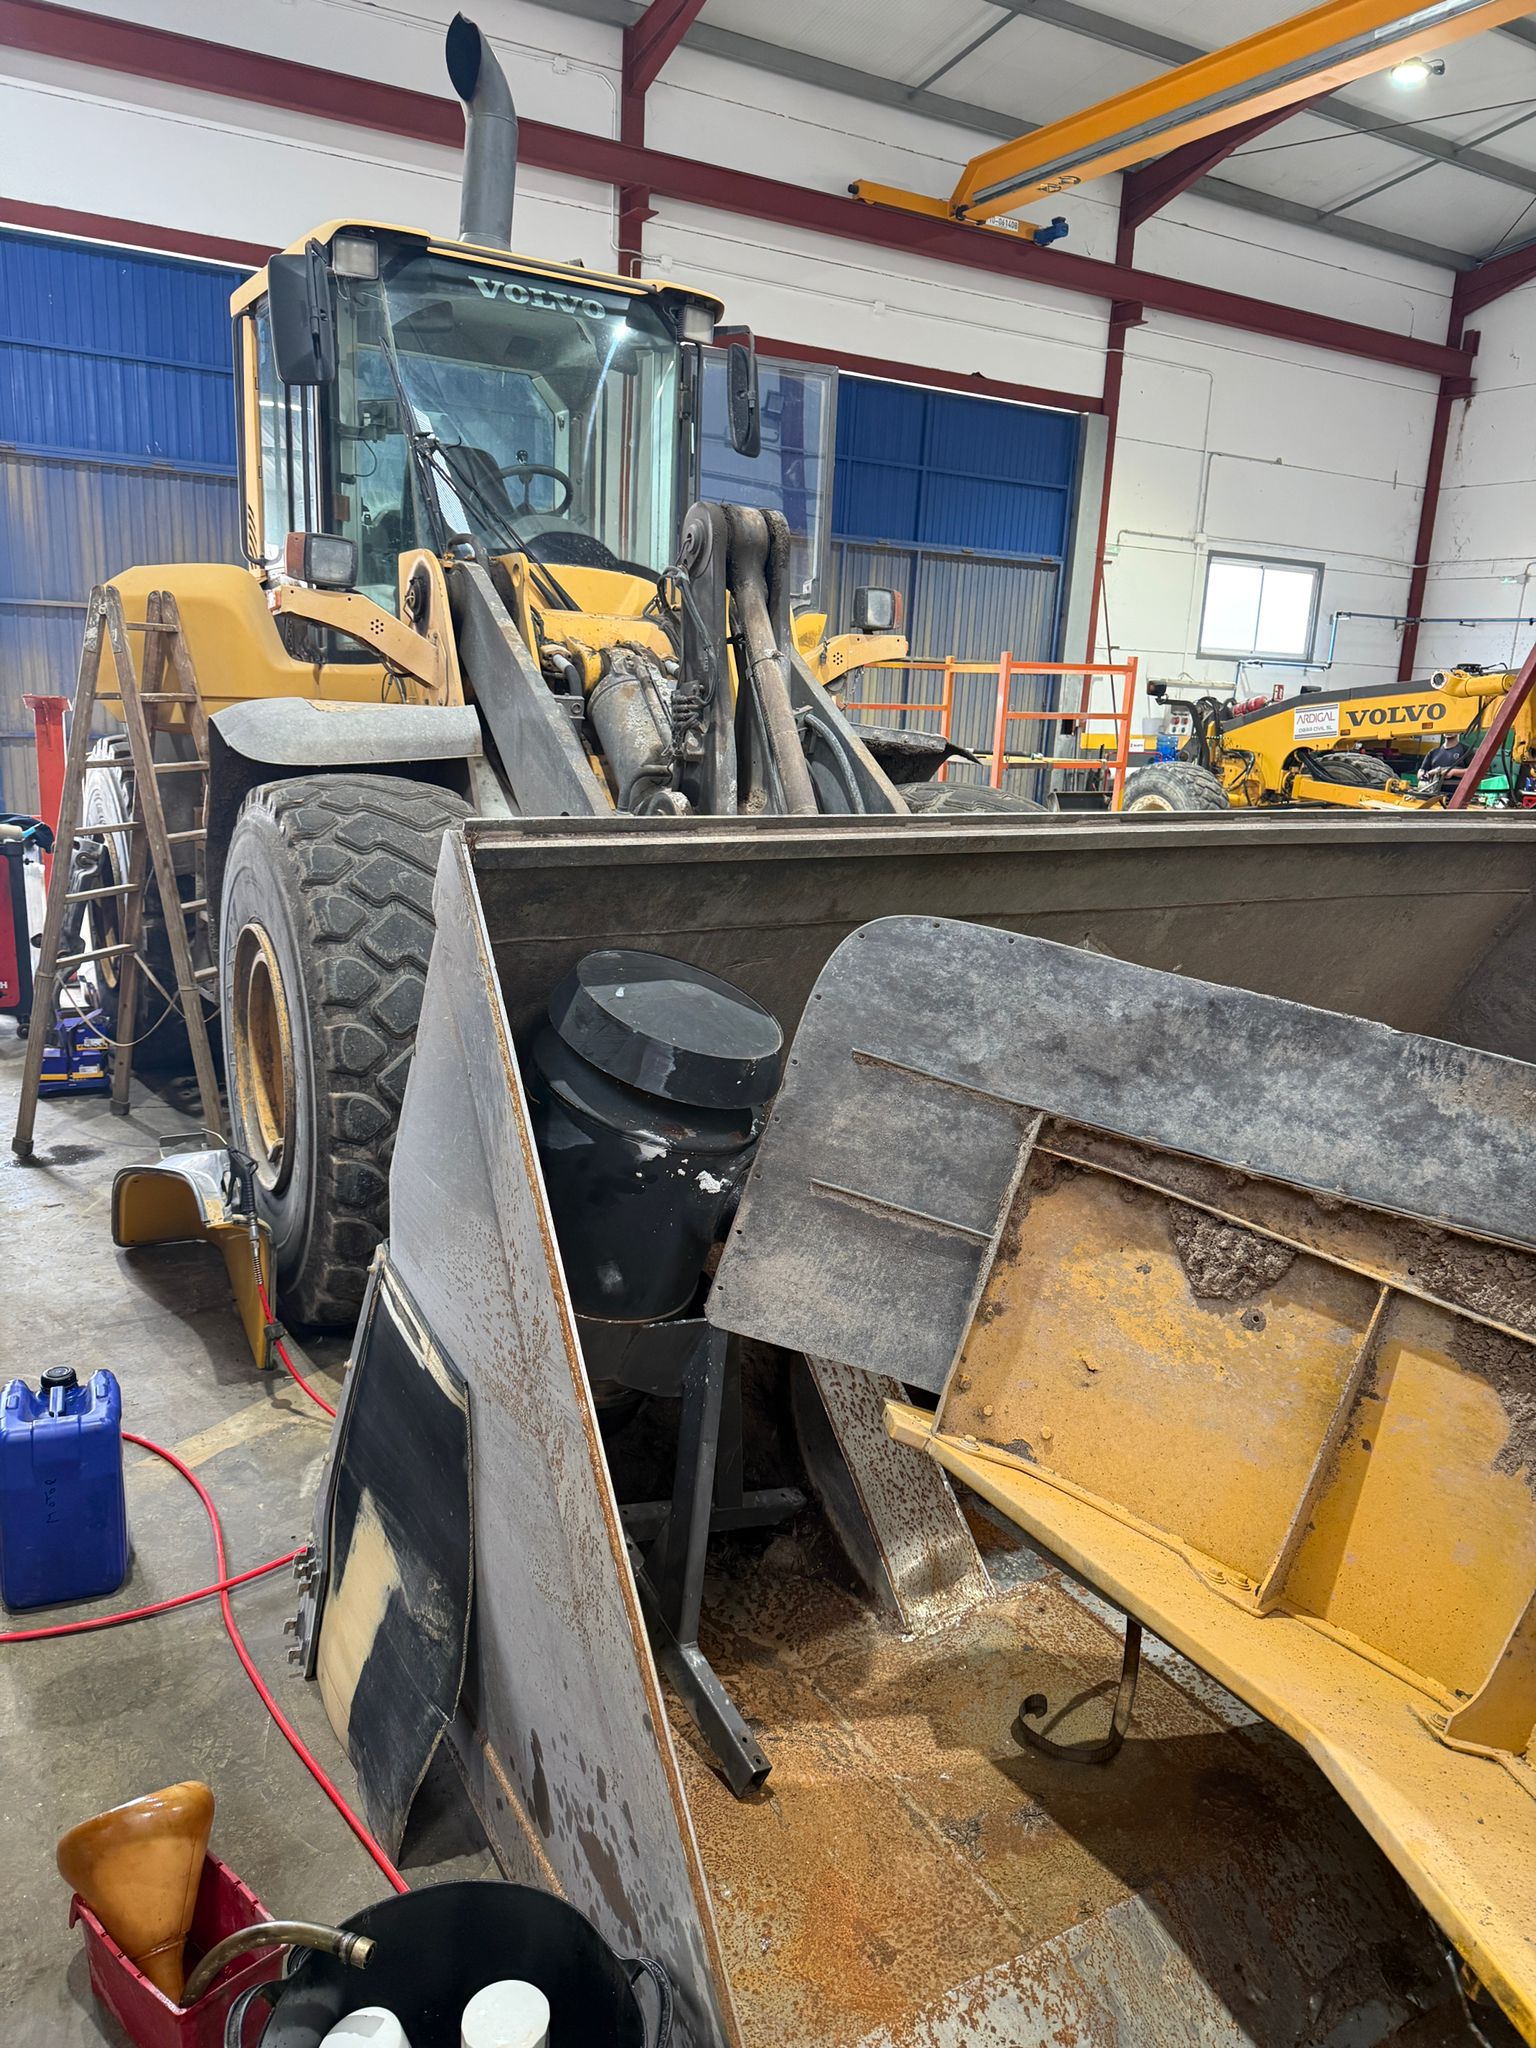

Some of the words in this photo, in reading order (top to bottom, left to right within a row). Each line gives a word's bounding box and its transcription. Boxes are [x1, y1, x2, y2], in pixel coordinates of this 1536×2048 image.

[468, 276, 606, 319] VOLVO
[1296, 711, 1336, 725] ARDIGAL
[1346, 703, 1446, 727] VOLVO
